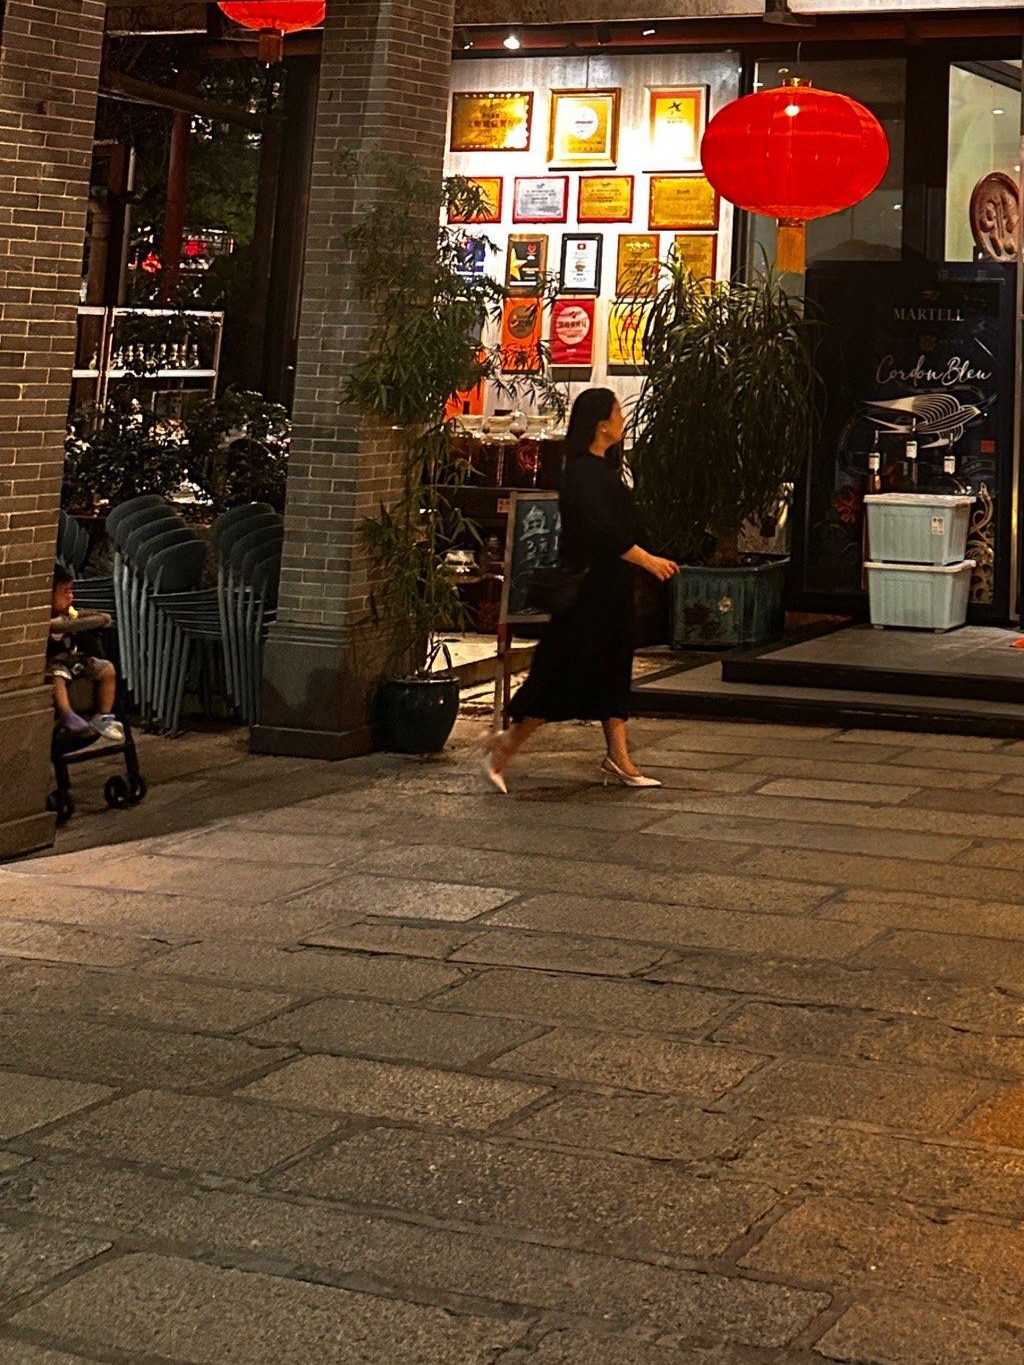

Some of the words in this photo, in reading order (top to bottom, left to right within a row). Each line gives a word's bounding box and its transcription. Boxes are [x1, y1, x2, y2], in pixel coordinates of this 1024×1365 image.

[894, 307, 965, 322] MARTELL
[875, 354, 942, 387] Cordon
[941, 356, 993, 386] Bleu
